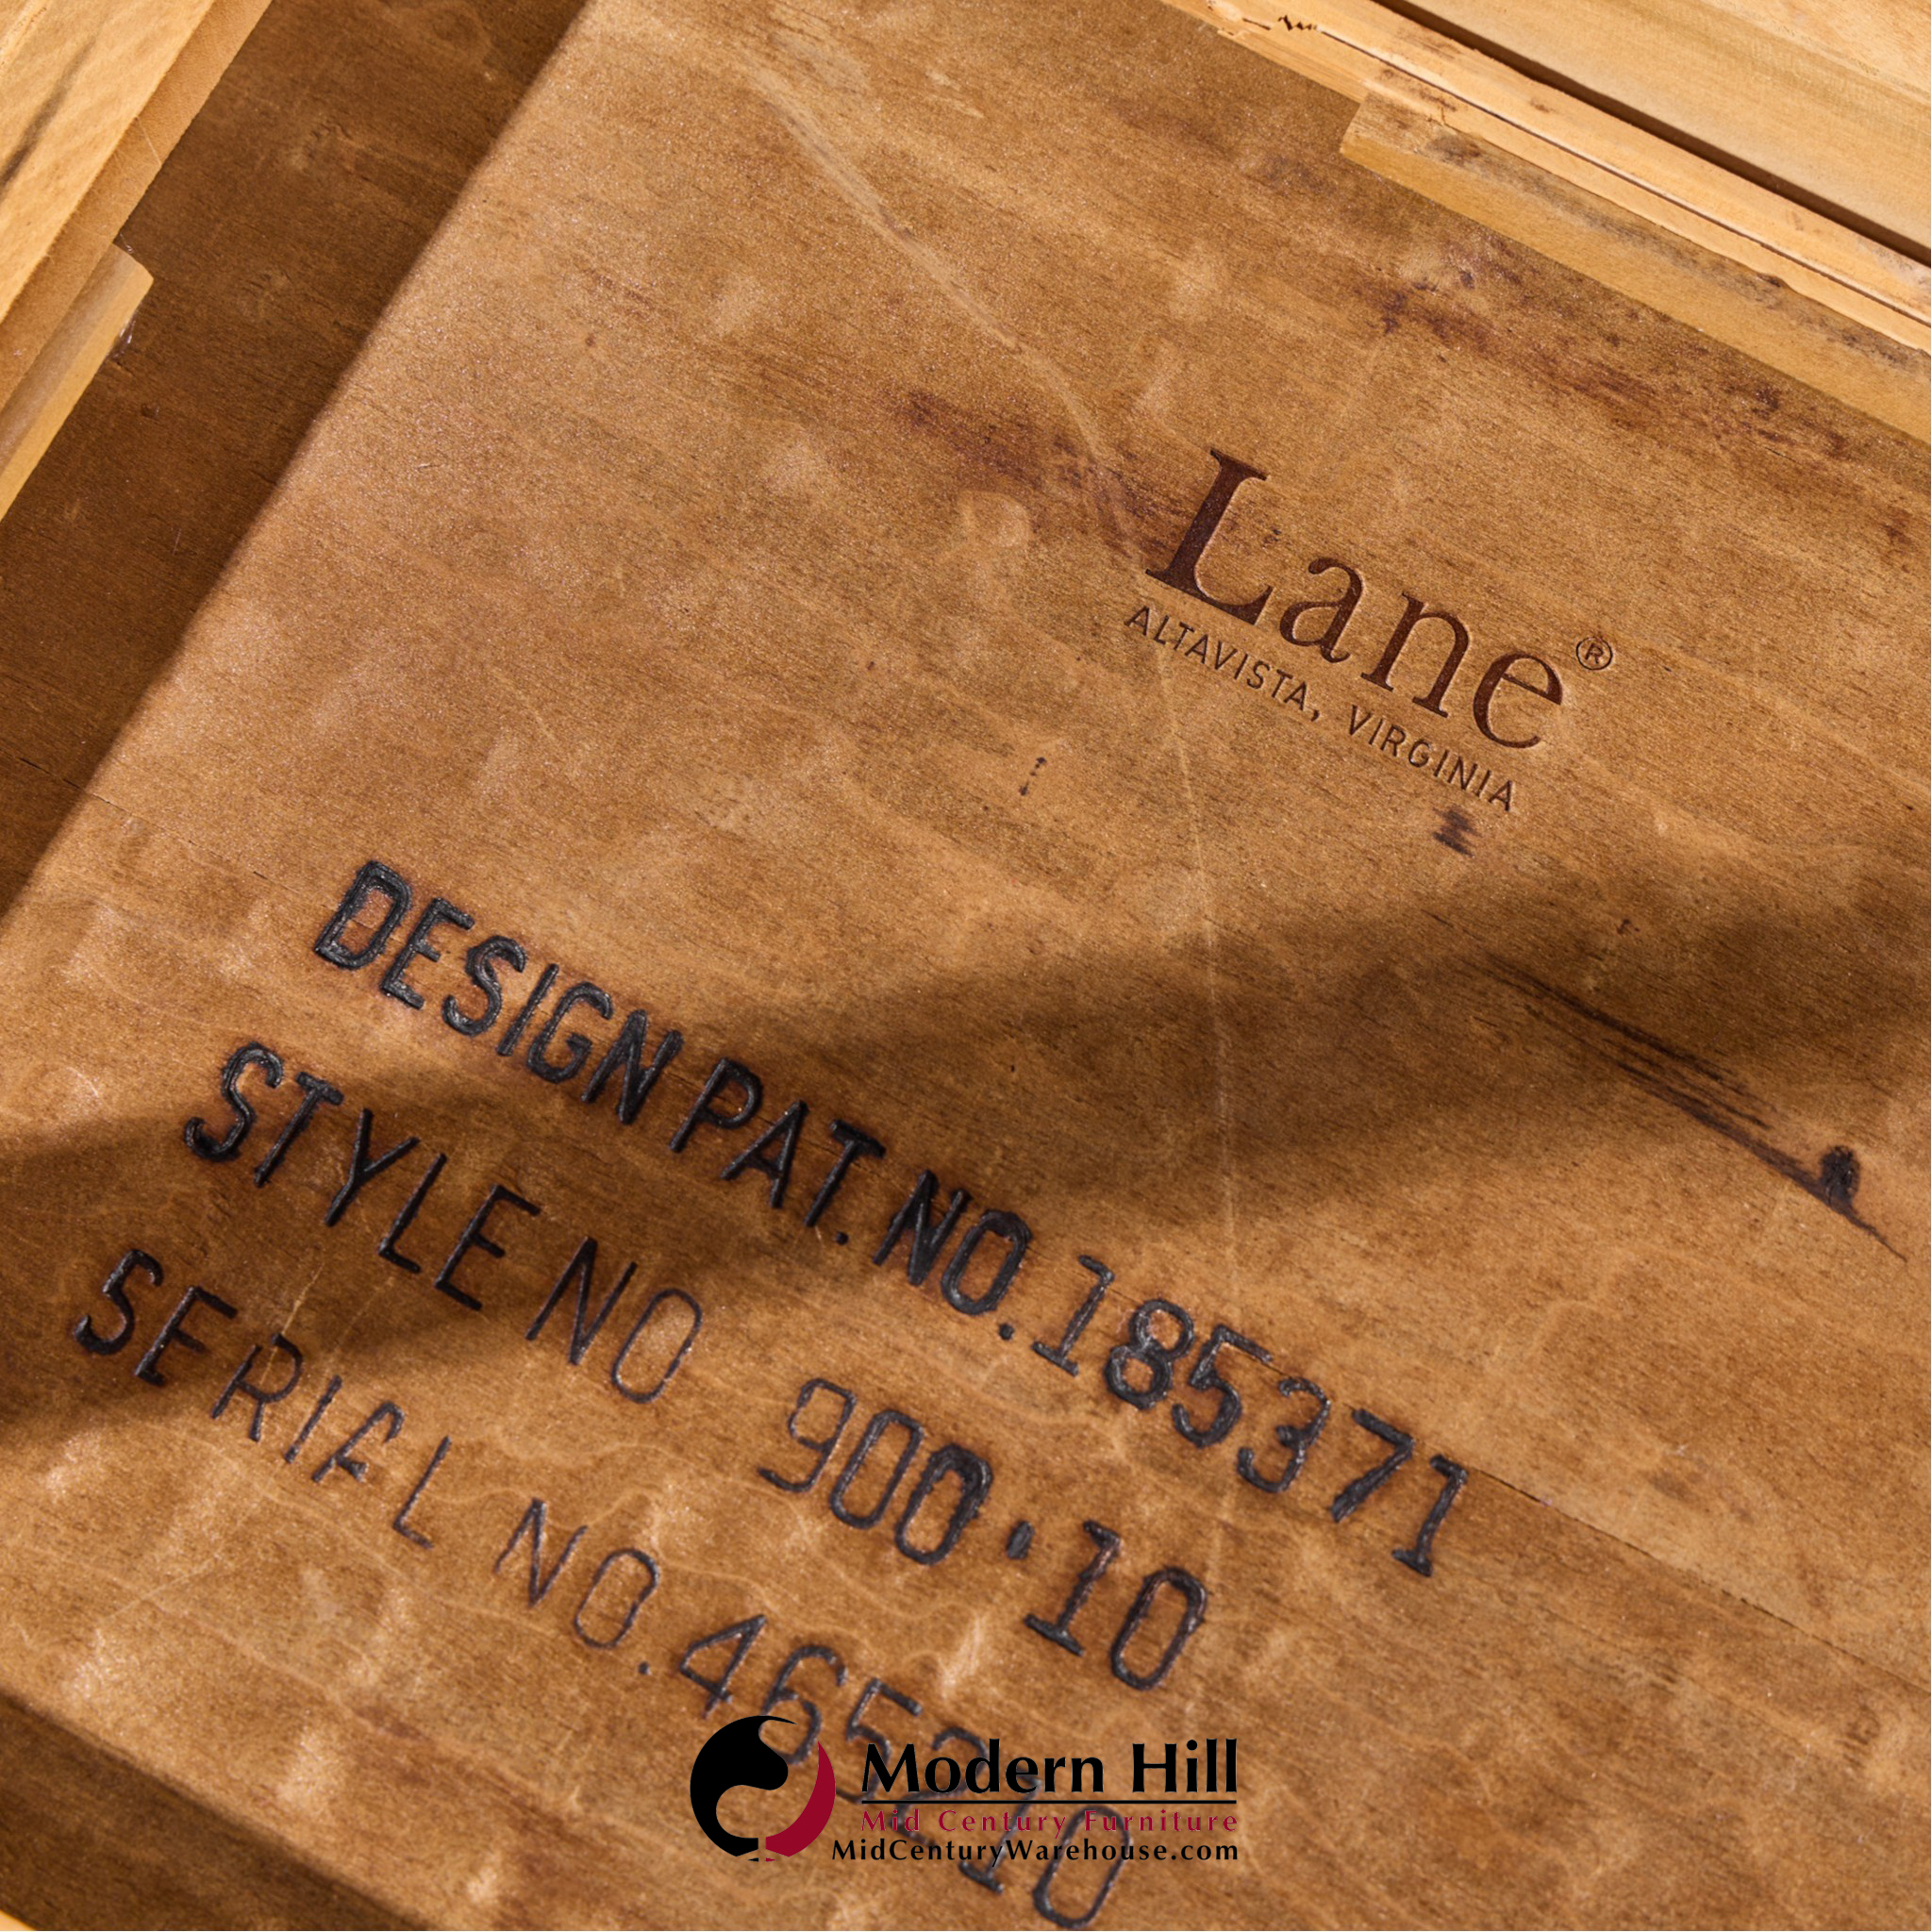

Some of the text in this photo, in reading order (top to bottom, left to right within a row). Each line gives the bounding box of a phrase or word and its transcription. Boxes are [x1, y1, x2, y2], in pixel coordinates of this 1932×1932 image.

[1124, 605, 1517, 813] ALTAVISTA, VIRGINIA
[313, 859, 685, 1126] DESIGN
[183, 1041, 541, 1311] STYLE
[525, 1237, 705, 1405] NO
[72, 1248, 451, 1550] SERIAL
